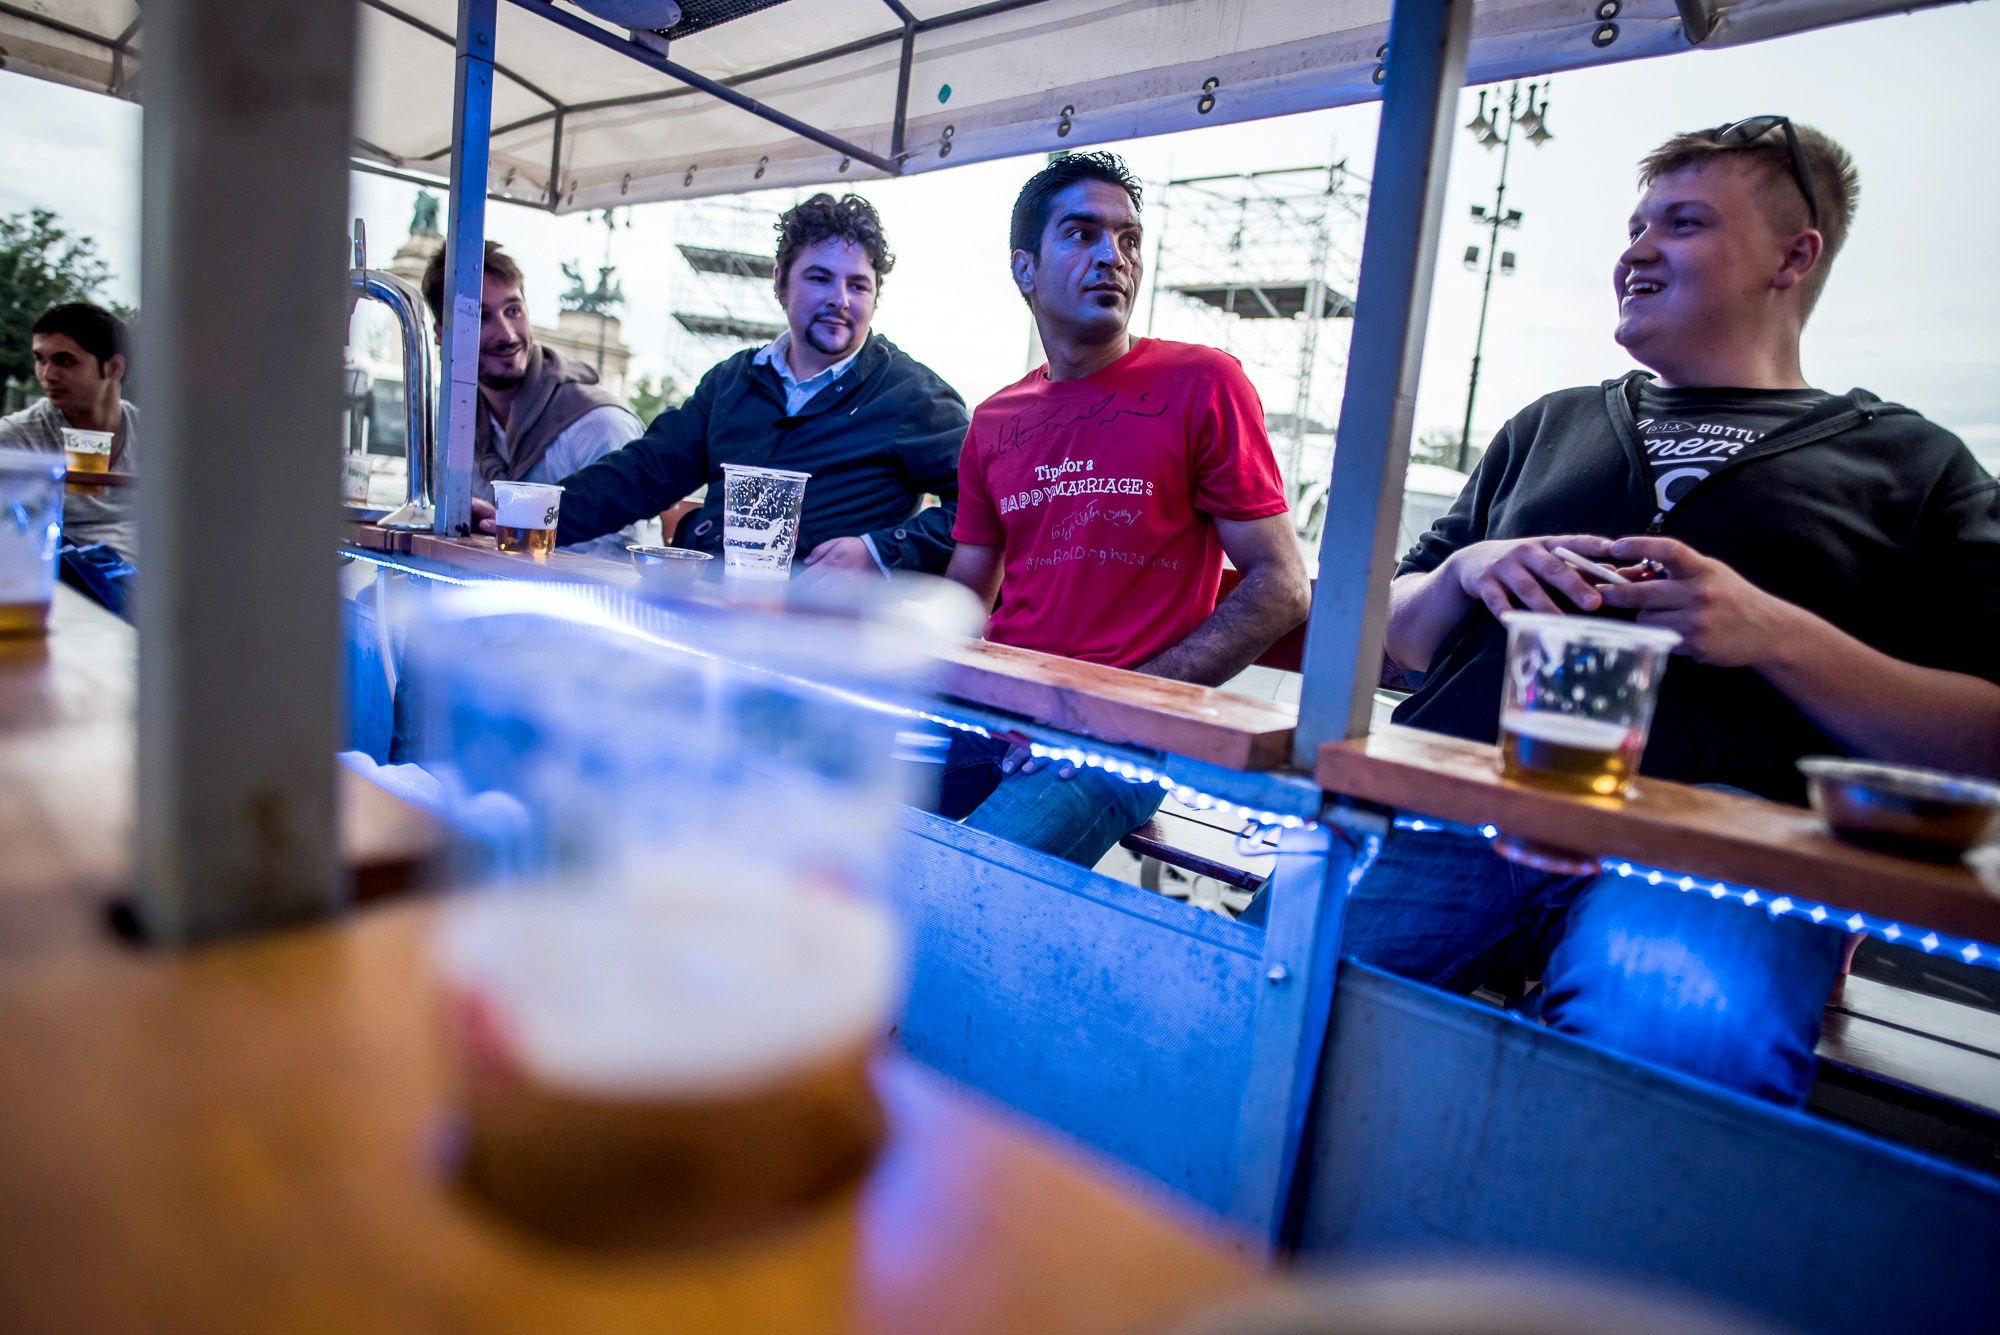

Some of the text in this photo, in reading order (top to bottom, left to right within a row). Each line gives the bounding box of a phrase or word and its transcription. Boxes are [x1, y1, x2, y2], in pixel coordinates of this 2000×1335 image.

[1060, 457, 1084, 472] for
[1086, 459, 1094, 471] a
[1000, 485, 1056, 514] HAPPY
